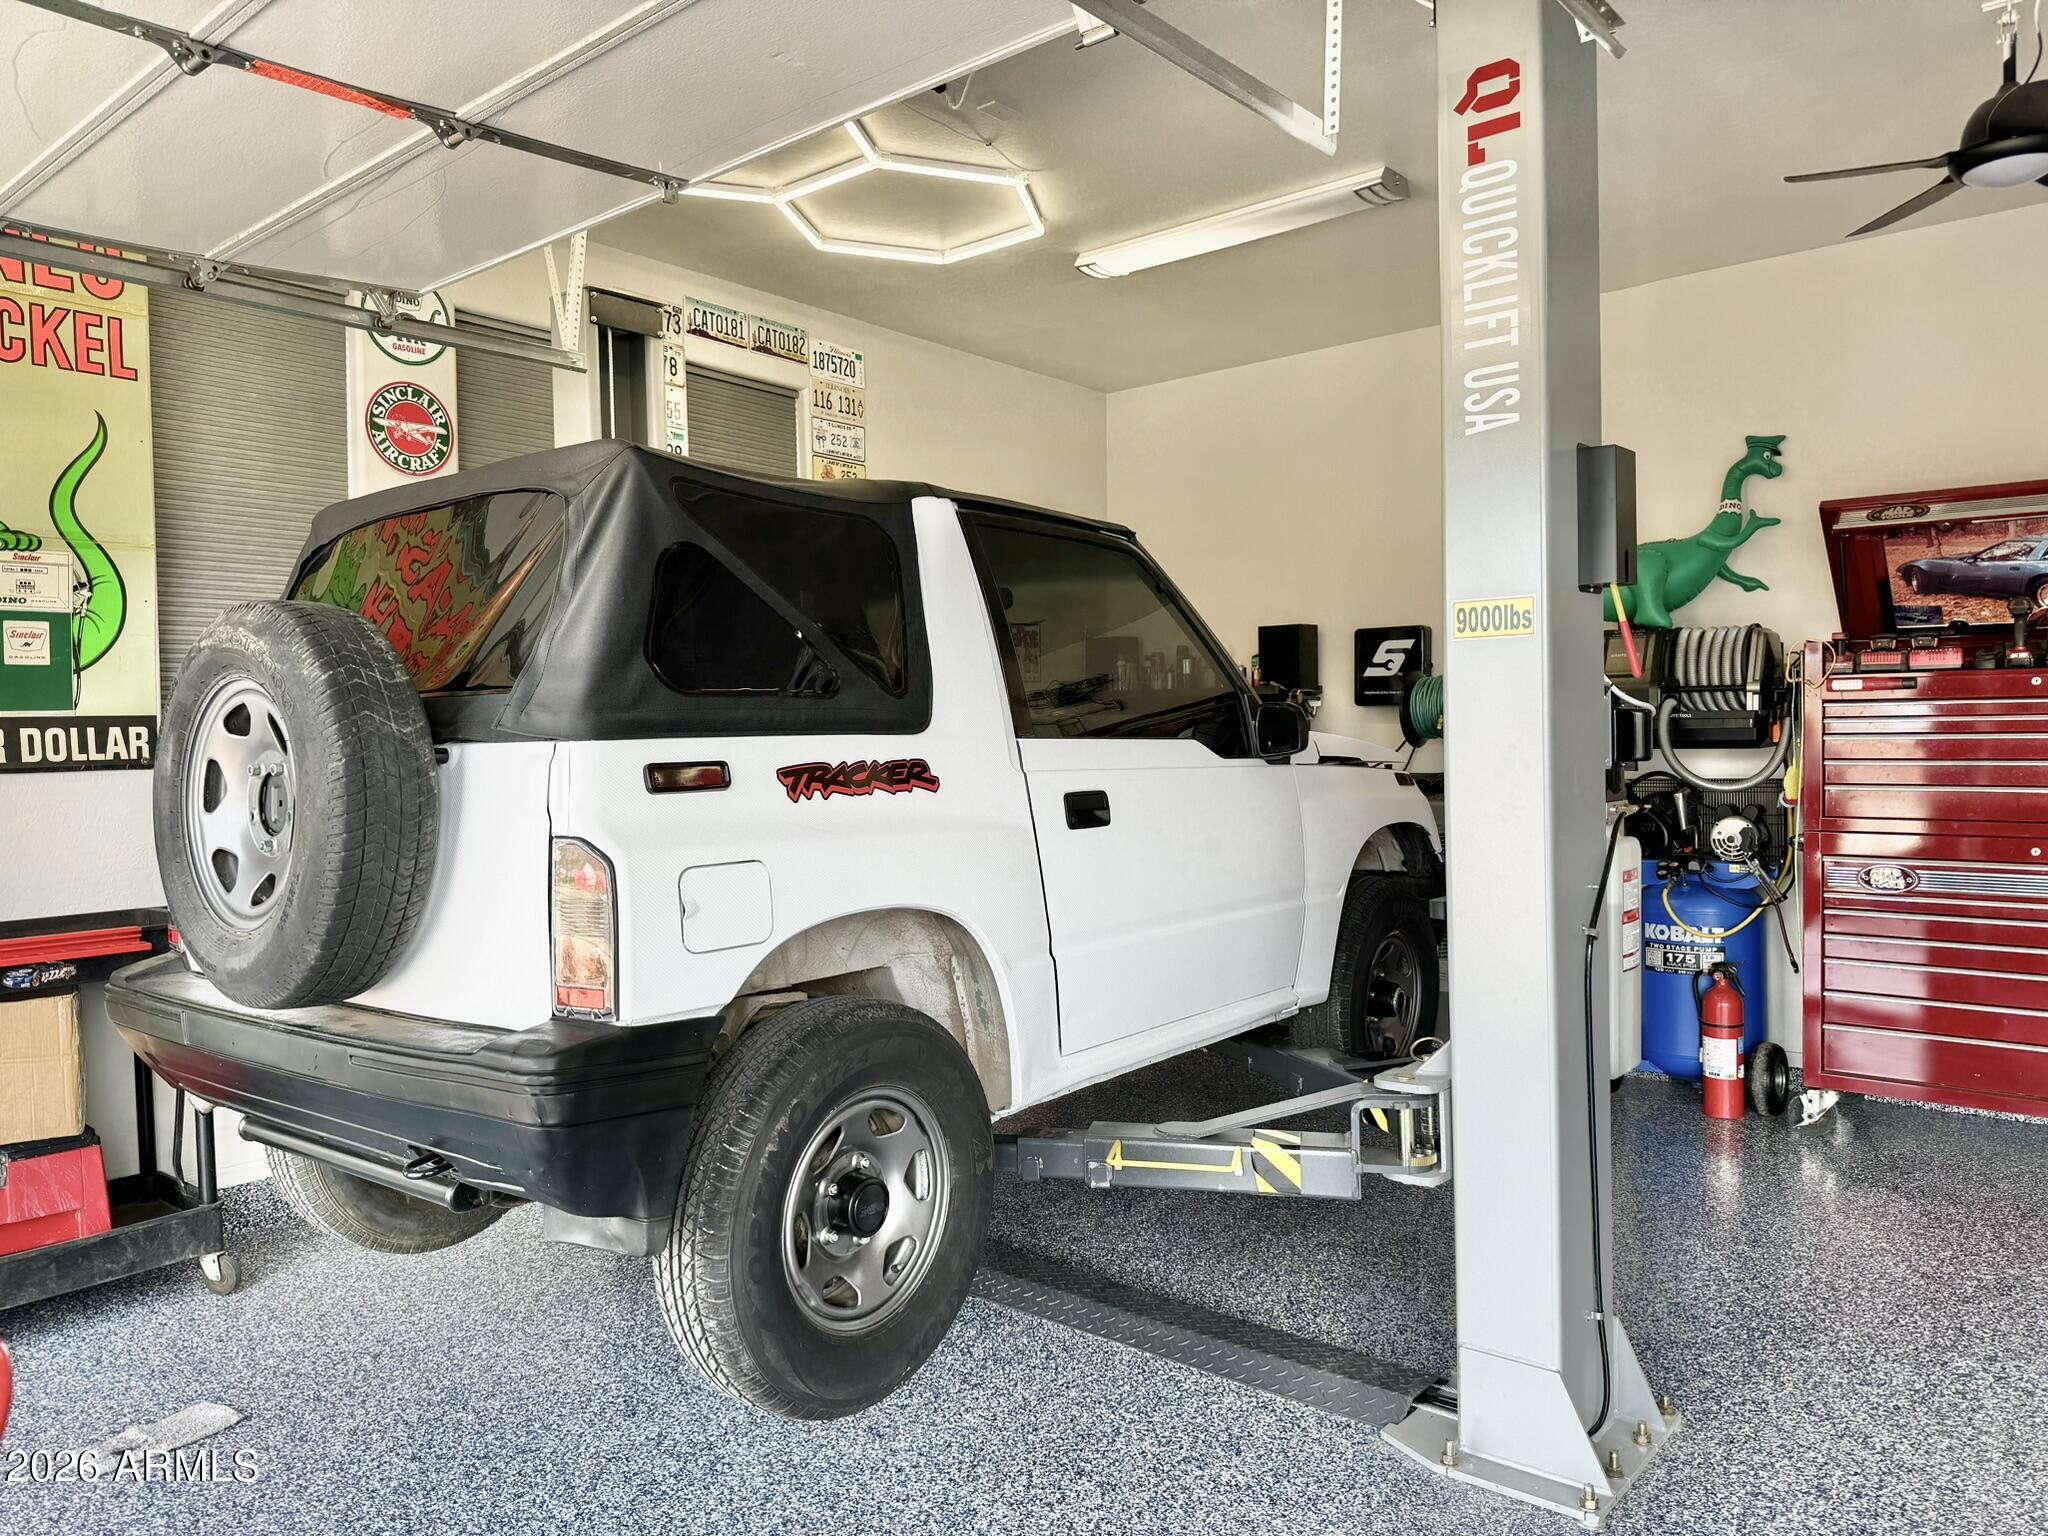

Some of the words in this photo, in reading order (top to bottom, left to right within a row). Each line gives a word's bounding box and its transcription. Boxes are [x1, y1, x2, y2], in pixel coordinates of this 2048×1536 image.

[1453, 57, 1521, 167] QL
[1459, 159, 1519, 350] QUICKLIFT
[392, 342, 426, 355] GASOLINE
[813, 350, 856, 378] 1875720
[371, 386, 446, 426] SINCLAIR
[813, 389, 833, 410] 116
[838, 395, 857, 416] 131
[1463, 361, 1521, 436] USA
[371, 428, 448, 472] AIRCRAFT
[830, 433, 848, 448] 252
[12, 552, 42, 561] Sinclair
[1456, 603, 1533, 634] 9000lbs
[10, 629, 45, 640] Sinclair
[20, 726, 150, 763] DOLLAR
[776, 758, 941, 804] TRACKER
[1644, 922, 1725, 944] KOBALT
[1665, 952, 1696, 964] 175
[1666, 944, 1691, 952] STAGE
[1694, 945, 1718, 953] PUMP
